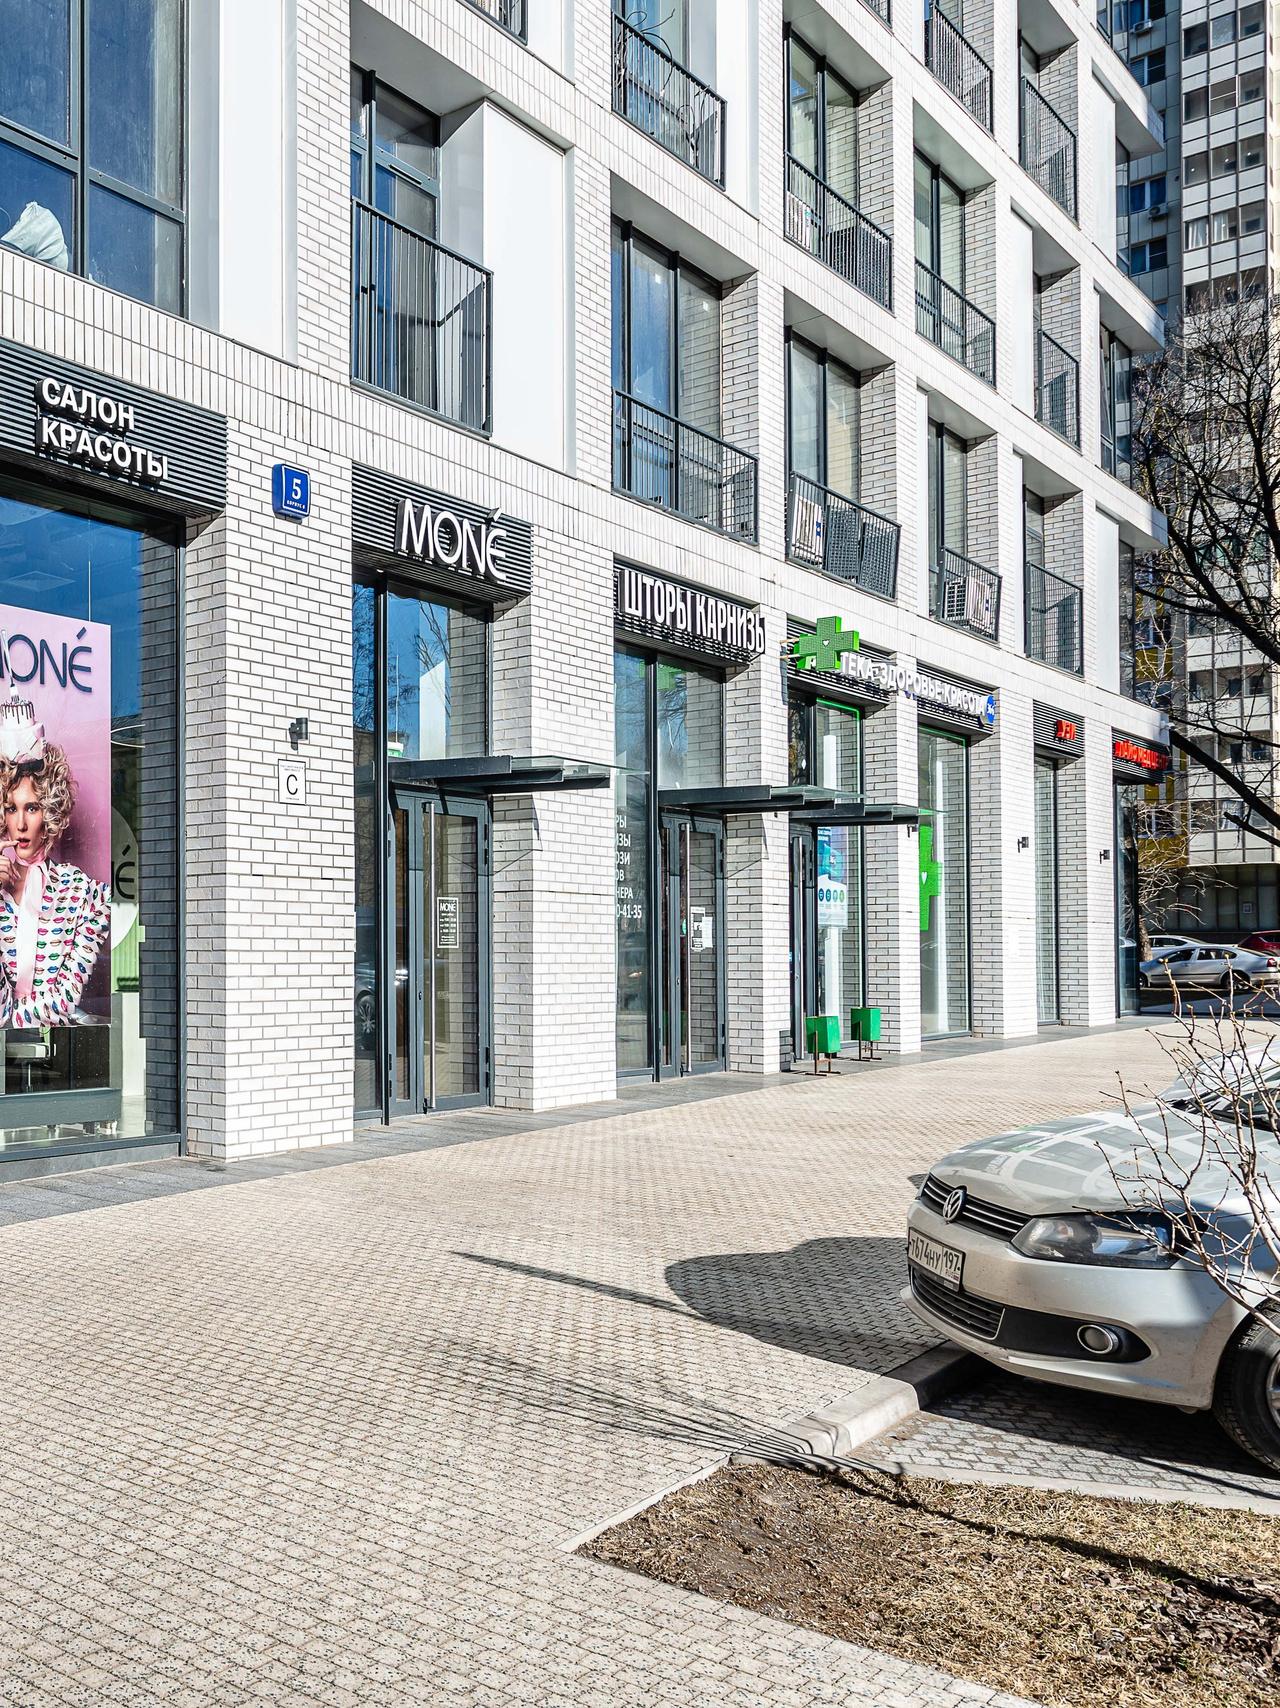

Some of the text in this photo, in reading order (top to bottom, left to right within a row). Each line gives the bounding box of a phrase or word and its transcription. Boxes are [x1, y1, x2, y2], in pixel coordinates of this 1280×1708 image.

[42, 377, 135, 431] САЛОН
[42, 417, 168, 480] КРАСОТЫ
[291, 477, 302, 500] 5
[401, 498, 507, 580] MONÉ
[624, 569, 692, 632] ШТОРЫ
